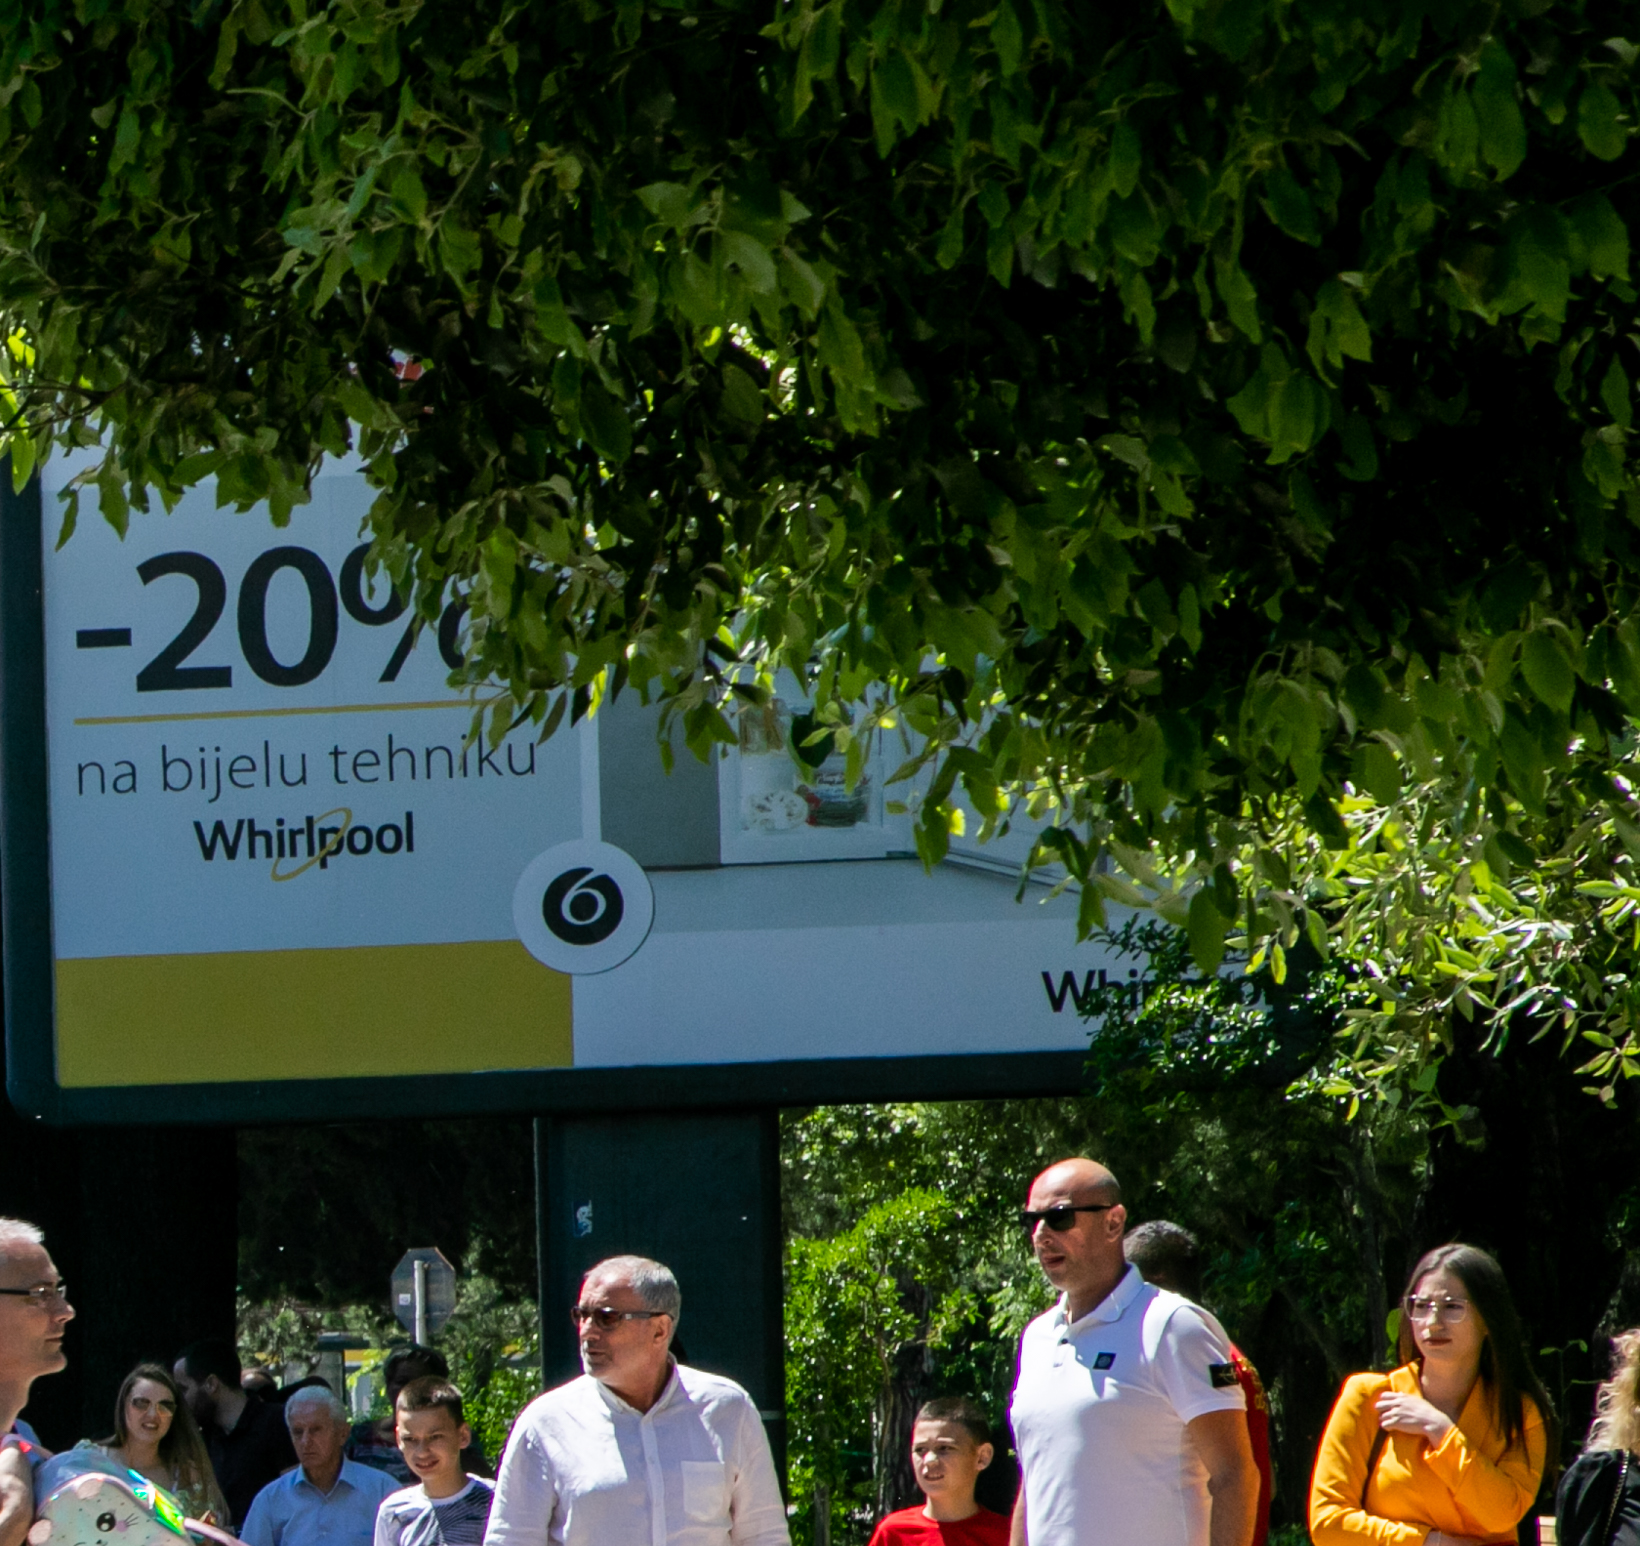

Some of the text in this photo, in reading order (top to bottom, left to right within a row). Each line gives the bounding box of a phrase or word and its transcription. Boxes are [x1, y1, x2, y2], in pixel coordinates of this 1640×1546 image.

[75, 731, 539, 804] na bijelu tehniku
[192, 809, 416, 872] Whirlpool
